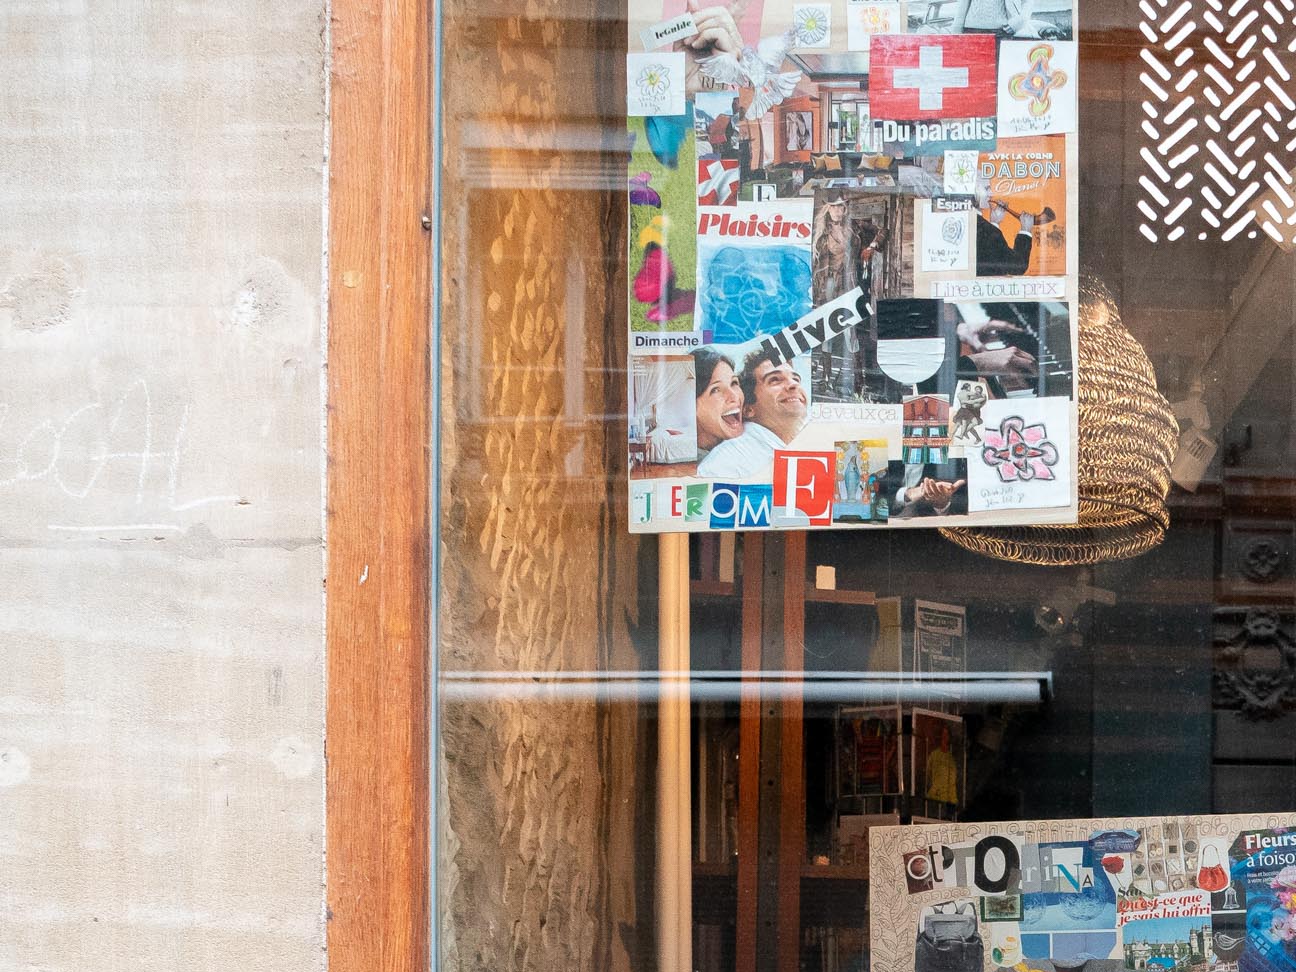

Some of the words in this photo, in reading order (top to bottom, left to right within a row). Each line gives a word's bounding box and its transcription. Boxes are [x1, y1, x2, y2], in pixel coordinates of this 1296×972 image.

[883, 119, 911, 142] Du
[915, 117, 995, 146] paradis
[981, 162, 1061, 179] DABON
[937, 198, 974, 211] Esprit
[698, 213, 812, 240] Plaisirs
[934, 281, 969, 297] Lire
[985, 280, 1019, 296] tout
[1023, 279, 1057, 298] prix
[635, 335, 698, 348] Dimanche
[1246, 852, 1256, 868] à
[1179, 894, 1203, 906] que
[1163, 906, 1179, 918] lui
